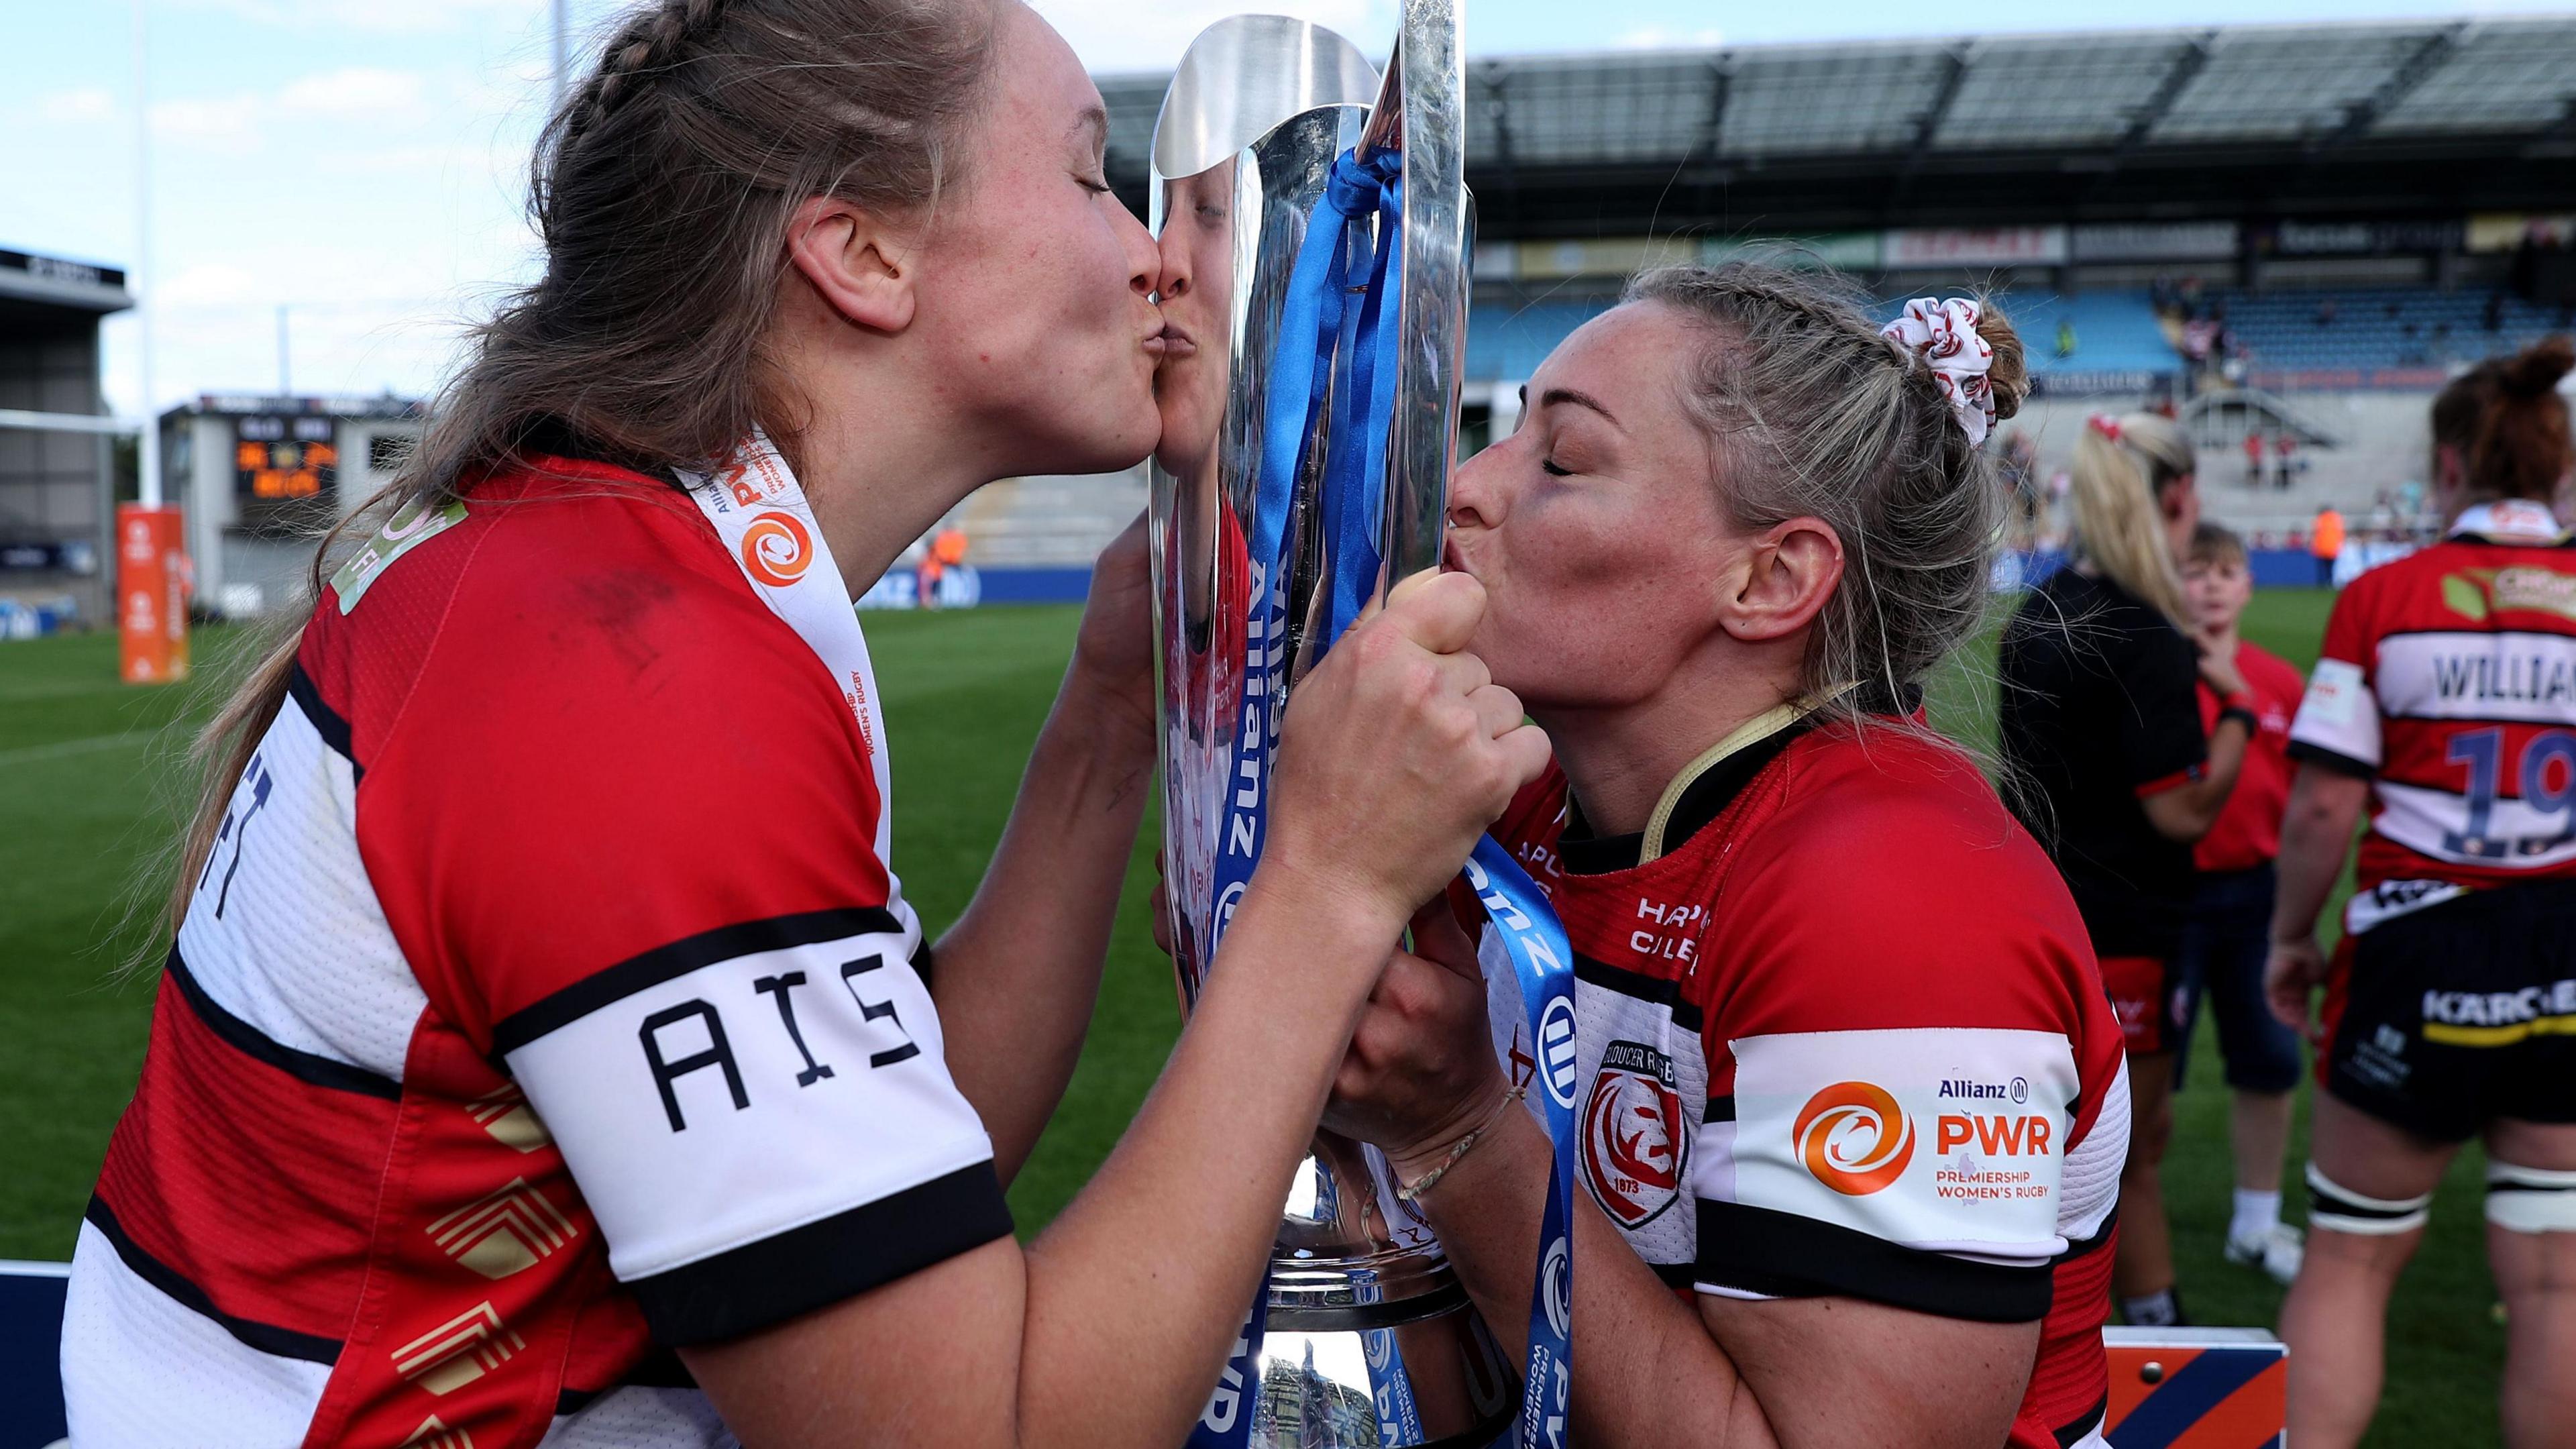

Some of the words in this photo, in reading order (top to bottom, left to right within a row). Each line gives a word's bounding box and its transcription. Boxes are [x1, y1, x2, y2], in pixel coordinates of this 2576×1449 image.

[851, 670, 867, 704] RUGBY
[2434, 653, 2576, 700] WILLIA
[1228, 560, 1267, 858] Allianz
[1938, 1080, 2006, 1099] Allianz
[1937, 1115, 2051, 1156] PWR
[1614, 1175, 1640, 1194] 1873
[1936, 1171, 2030, 1183] PREMIERSHIP
[1937, 1185, 2012, 1199] WOMEN'S
[2016, 1185, 2049, 1198] RUGBY
[1524, 1344, 1542, 1438] WOMEN'S
